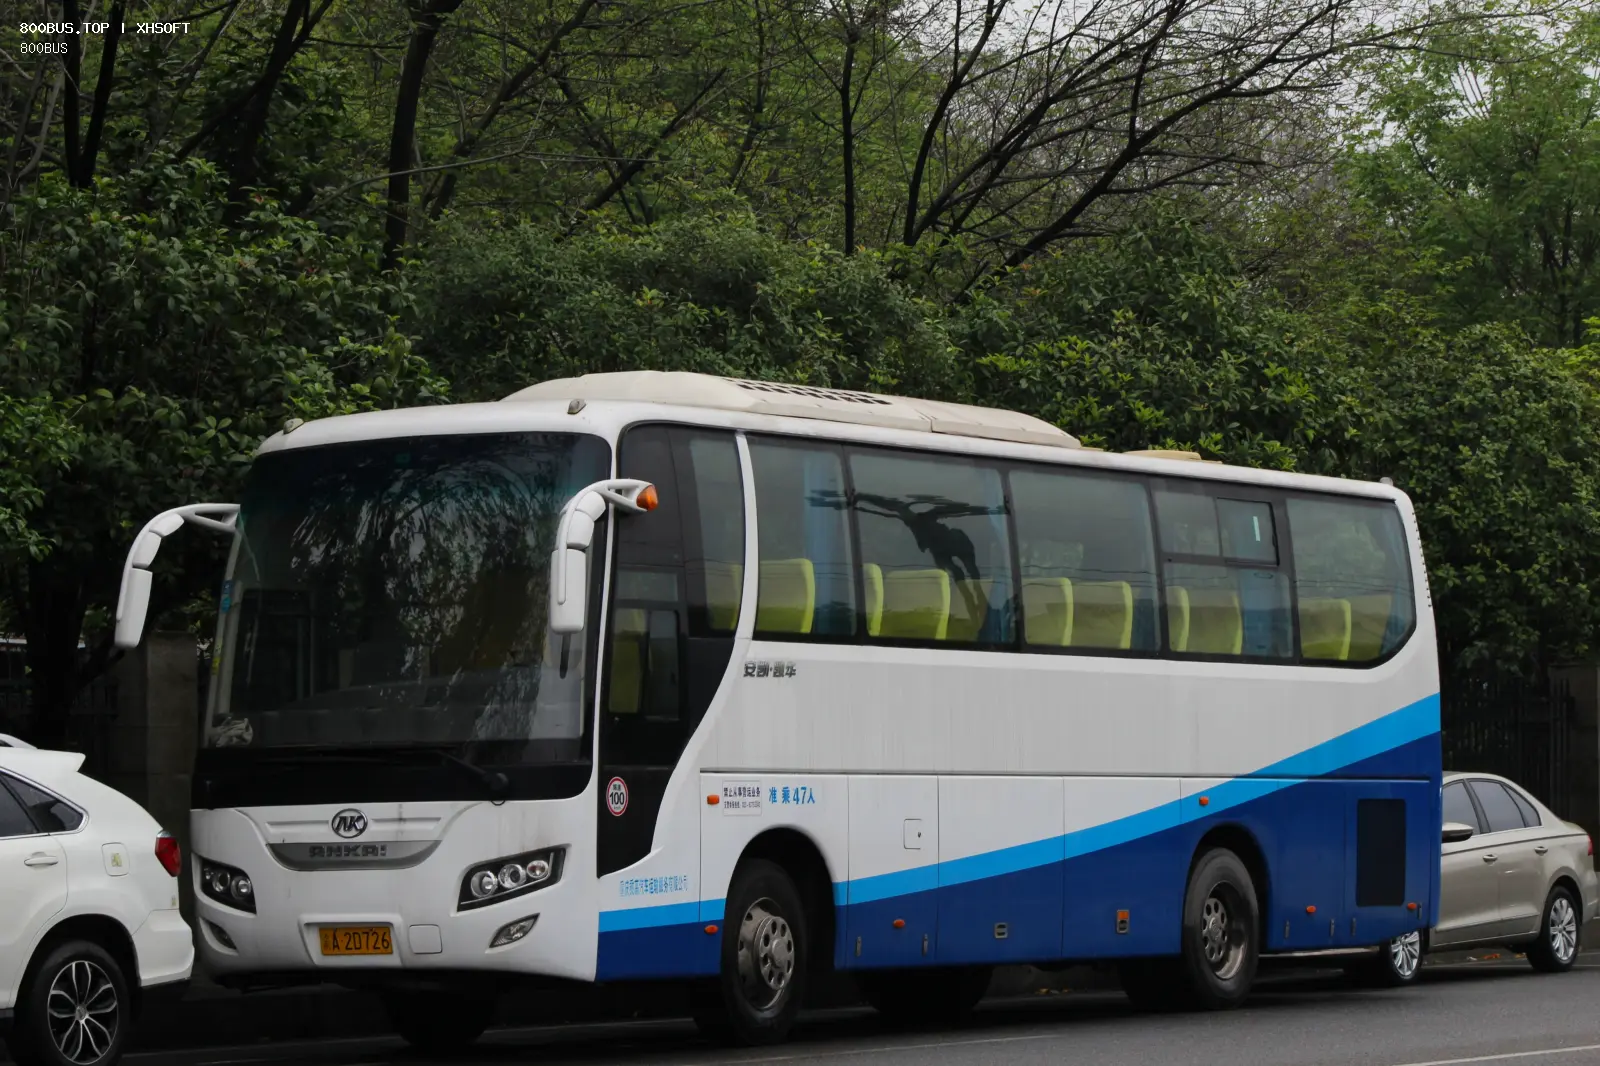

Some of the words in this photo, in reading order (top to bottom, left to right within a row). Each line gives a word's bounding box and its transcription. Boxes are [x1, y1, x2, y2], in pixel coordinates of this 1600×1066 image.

[609, 792, 625, 805] 100
[768, 786, 816, 805] 准乘47人
[309, 844, 388, 858] ANKAI
